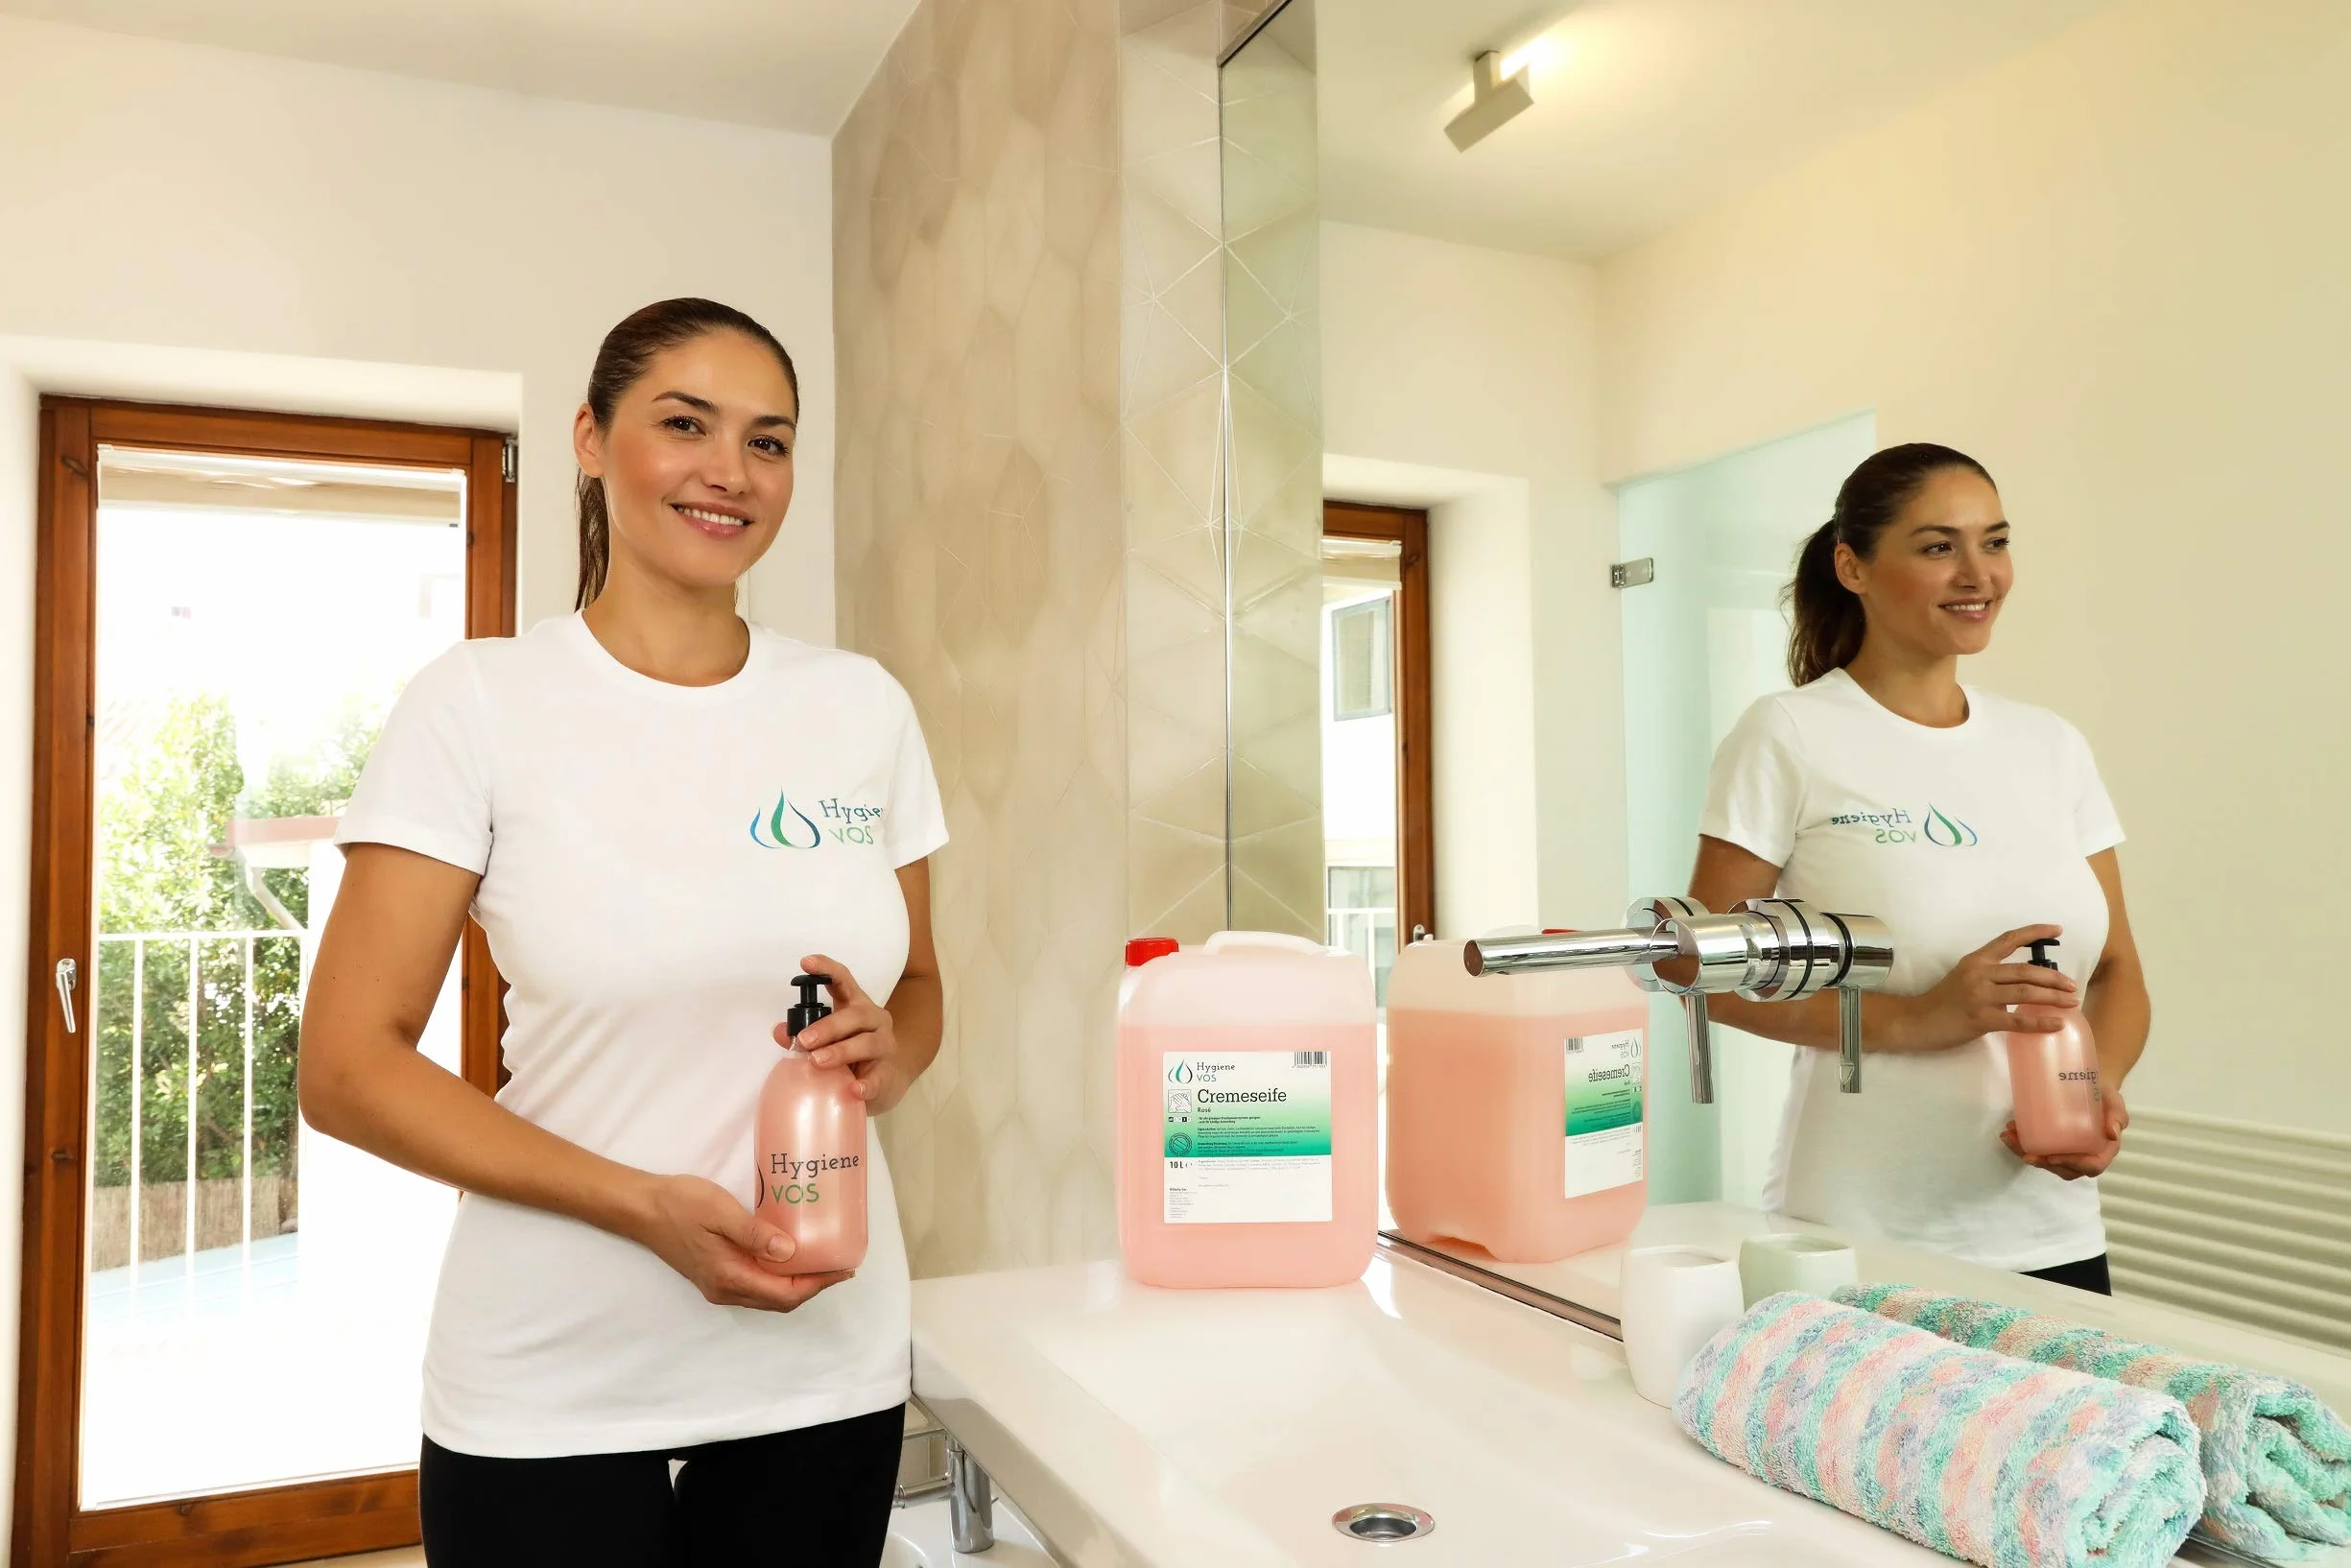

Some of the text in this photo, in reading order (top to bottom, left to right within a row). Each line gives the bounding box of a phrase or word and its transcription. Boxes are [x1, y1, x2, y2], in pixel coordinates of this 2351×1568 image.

[818, 797, 883, 824] Hygie
[828, 824, 874, 845] VOS
[1197, 1061, 1236, 1074] Hygiene
[1197, 1074, 1217, 1082] VOS
[1198, 1088, 1287, 1104] Cremeseife
[771, 1152, 860, 1180] Hygiene
[1170, 1160, 1178, 1169] 10
[771, 1183, 819, 1205] VOS
